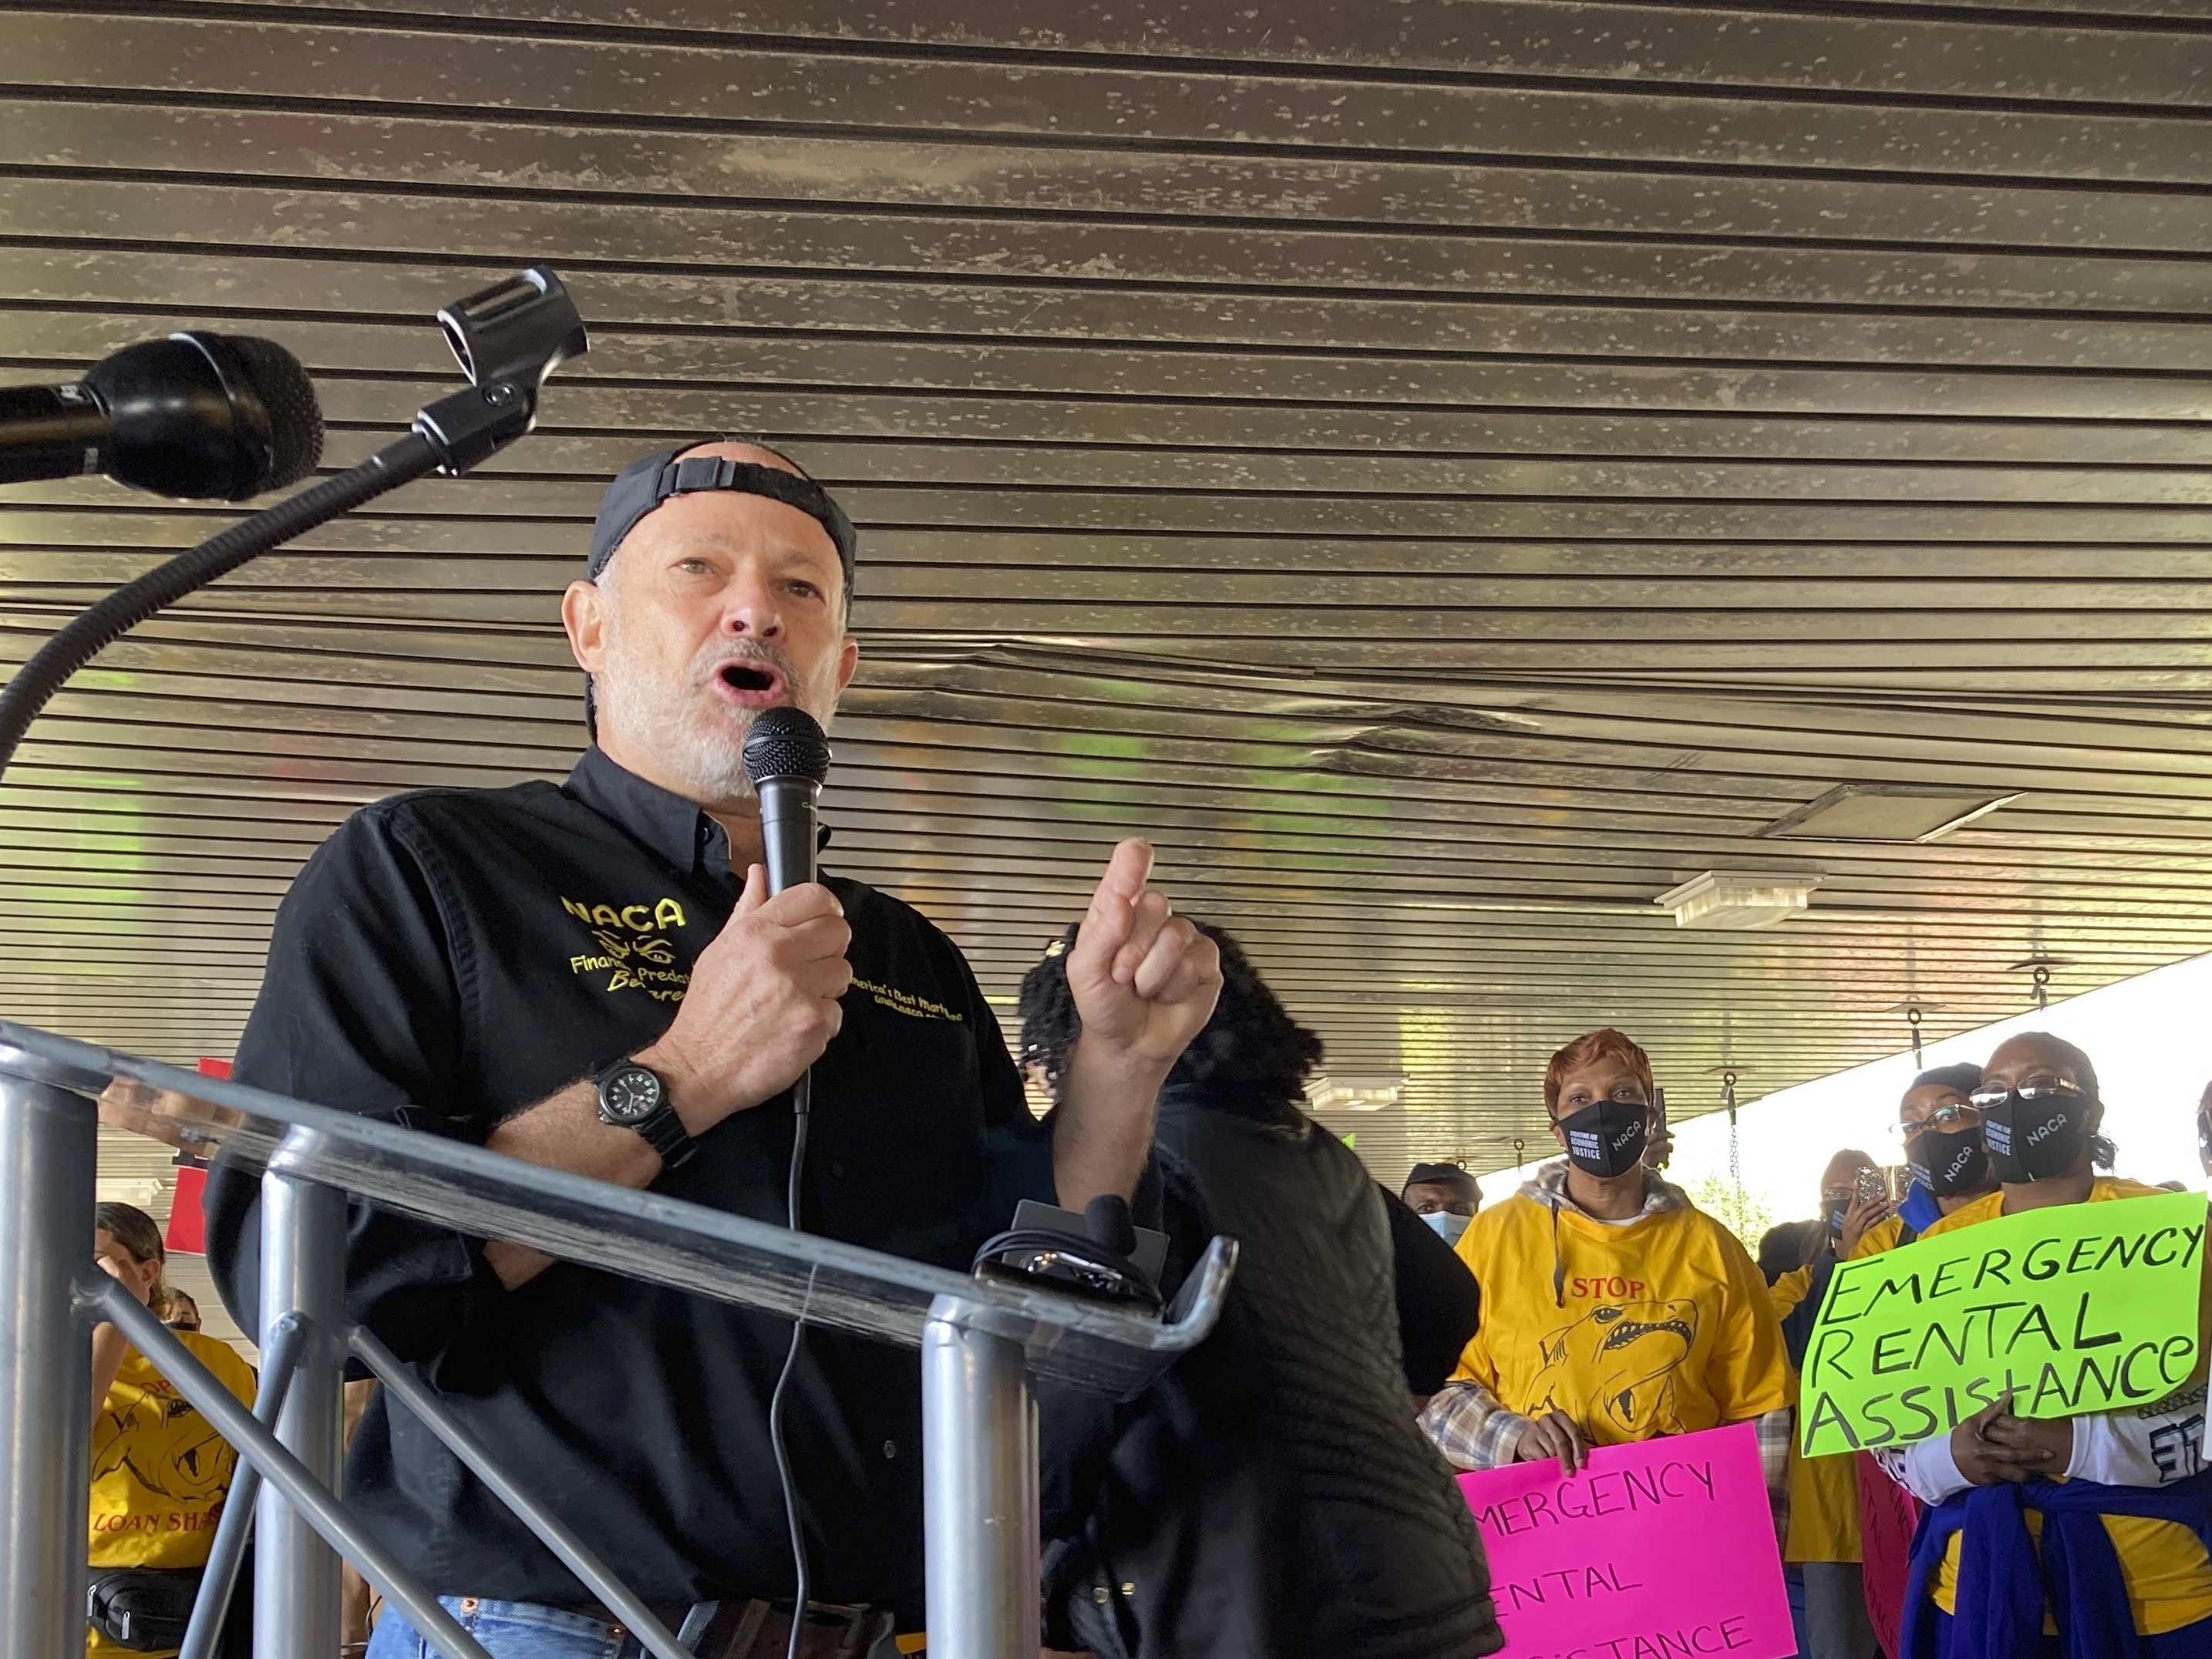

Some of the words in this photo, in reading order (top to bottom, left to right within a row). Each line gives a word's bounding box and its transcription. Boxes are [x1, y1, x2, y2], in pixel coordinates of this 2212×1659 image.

[561, 896, 686, 931] NACA
[638, 967, 692, 985] Preda
[850, 976, 893, 998] merica's
[894, 988, 916, 1006] Best
[1571, 1137, 1599, 1149] ECONOMIC
[1611, 1120, 1641, 1152] NACA
[2025, 1113, 2068, 1147] NACA
[1572, 1145, 1601, 1160] JUSTICE
[1943, 1146, 1973, 1183] NACA
[1571, 1276, 1645, 1299] STOP
[1820, 1223, 2204, 1326] EMERGENCY
[1811, 1291, 2122, 1388] RENTAL
[1474, 1461, 1715, 1536] MERGENCY
[92, 1513, 160, 1531] LOAN
[1488, 1563, 1643, 1618] NTAL
